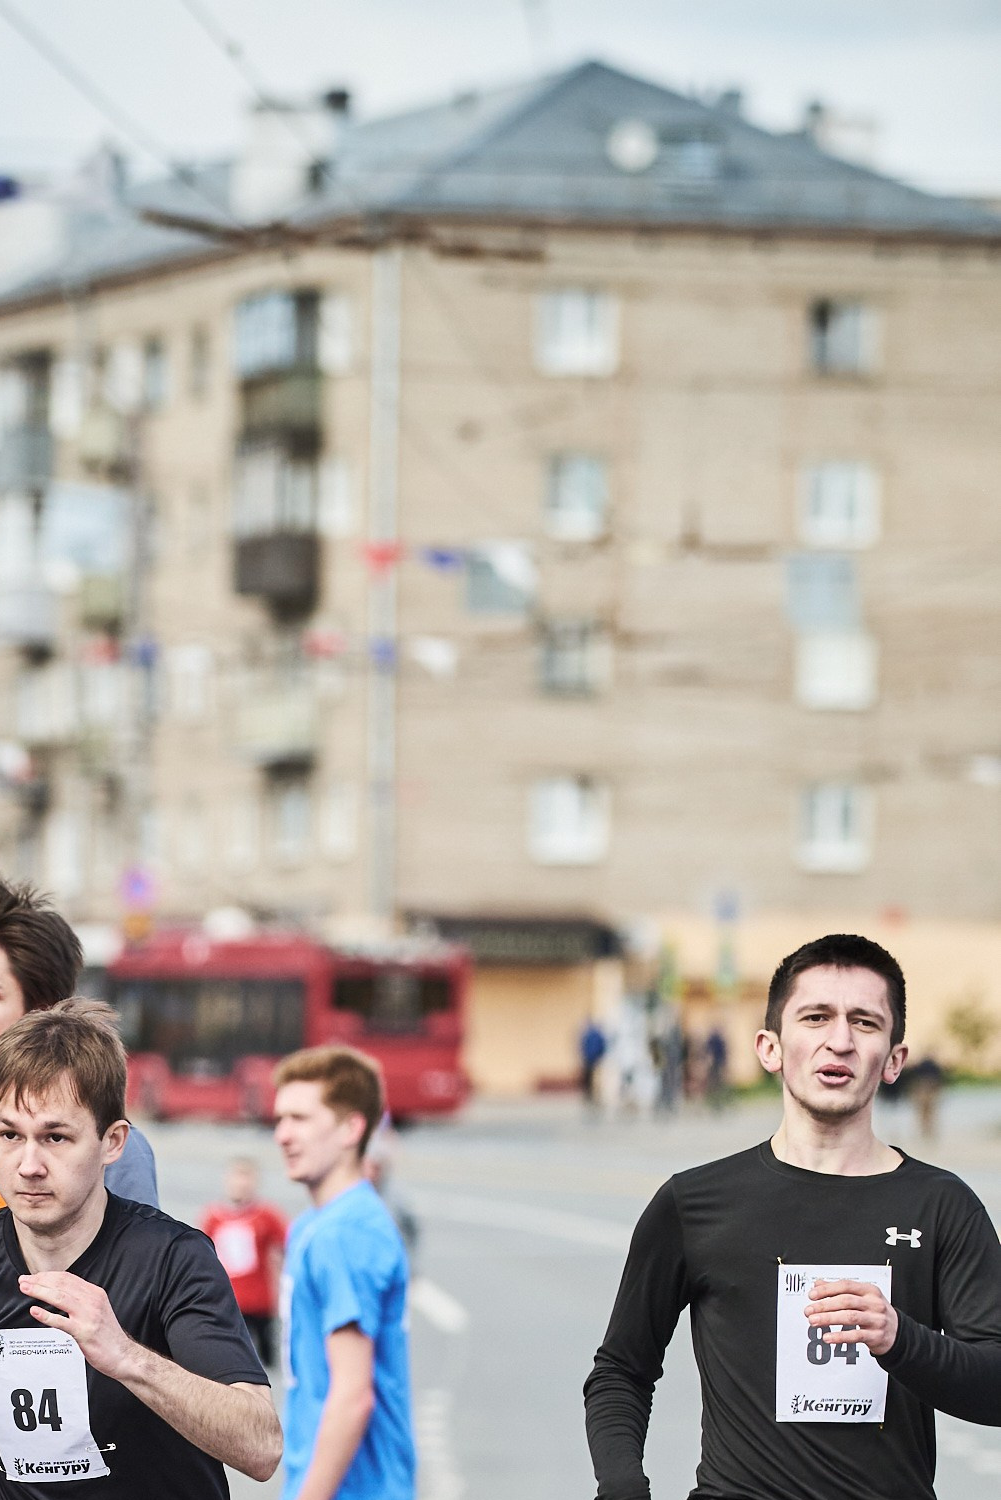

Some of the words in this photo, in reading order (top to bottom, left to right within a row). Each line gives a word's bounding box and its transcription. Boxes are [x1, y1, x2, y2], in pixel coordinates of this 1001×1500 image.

[10, 1388, 63, 1432] 84
[802, 1399, 872, 1416] Кенгуру
[25, 1462, 91, 1476] Кенгуру
